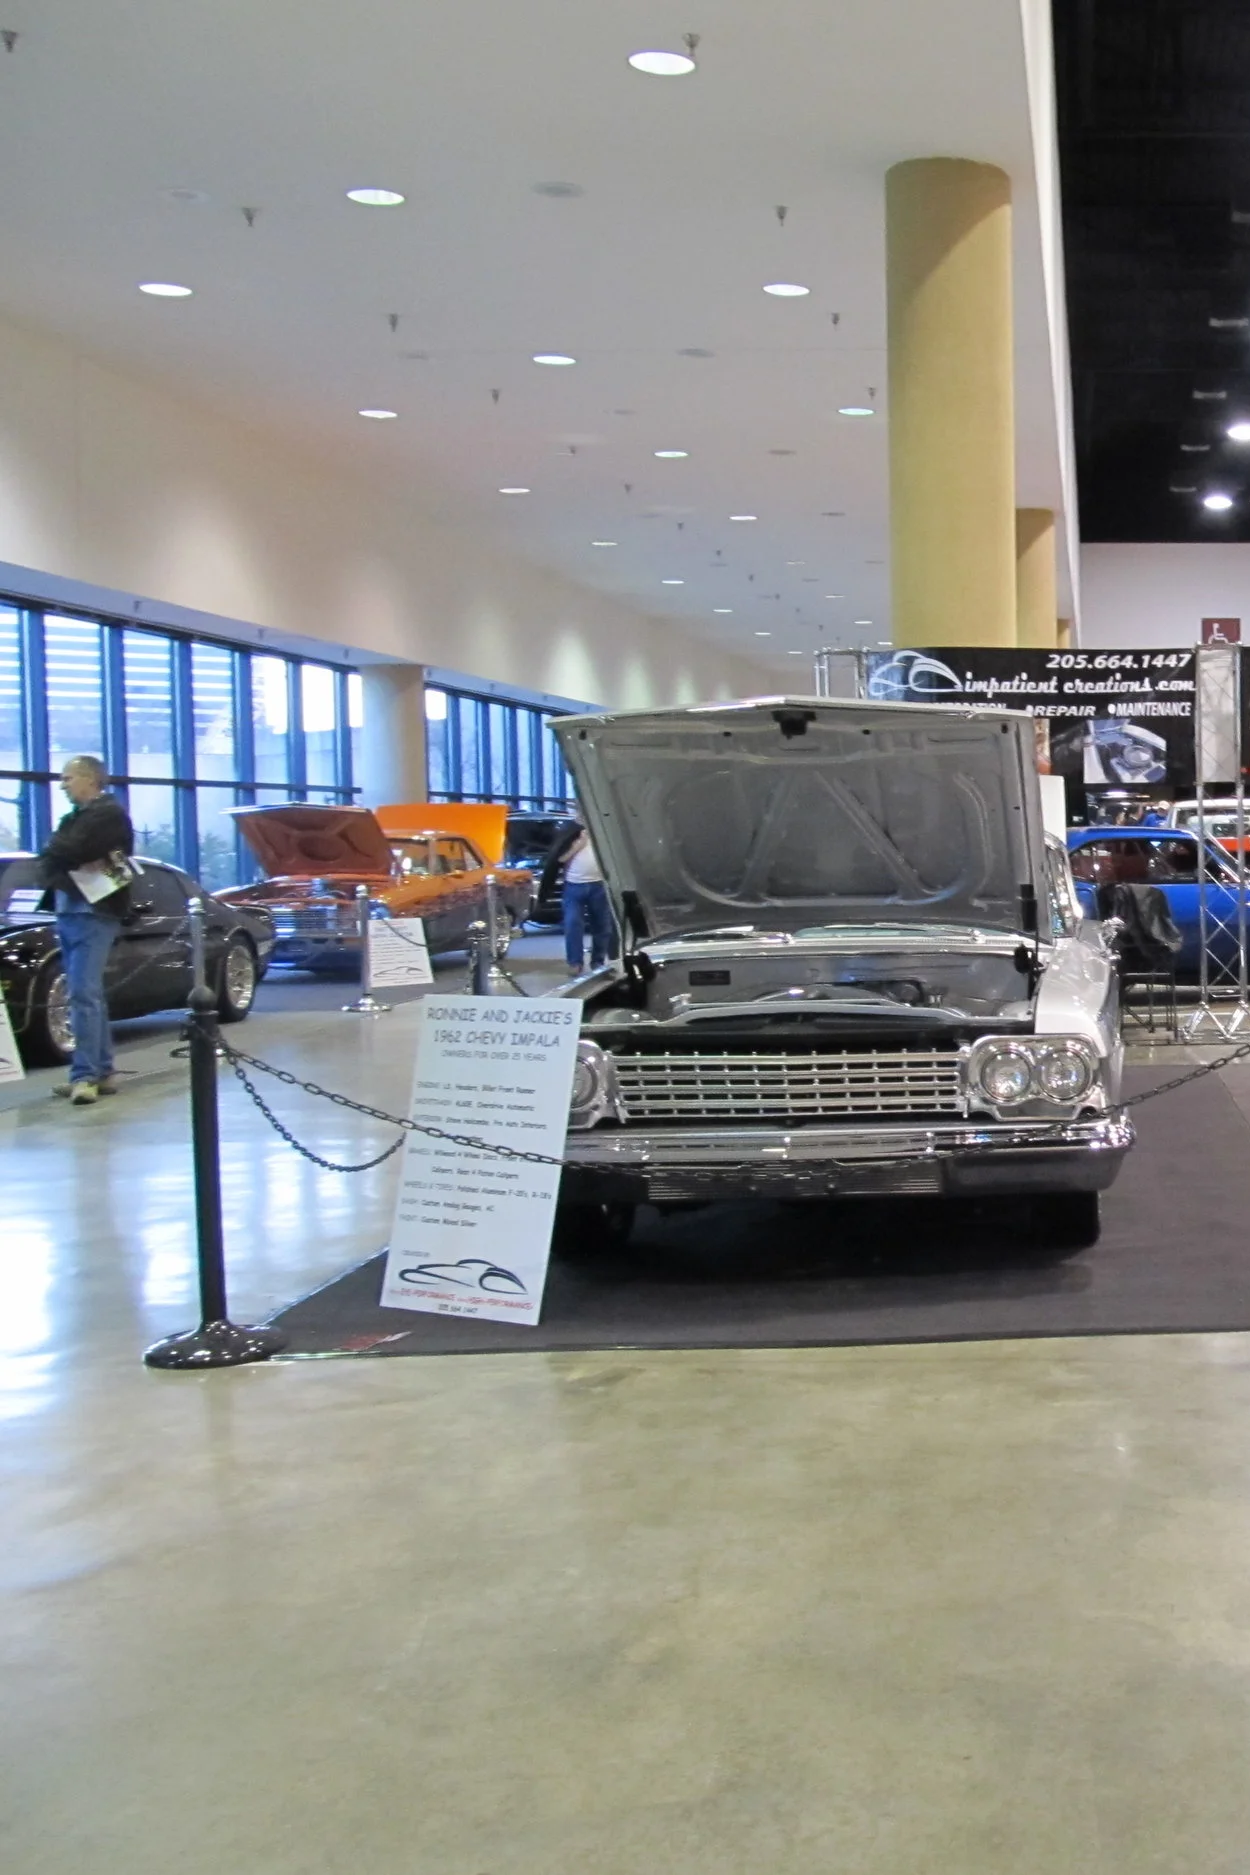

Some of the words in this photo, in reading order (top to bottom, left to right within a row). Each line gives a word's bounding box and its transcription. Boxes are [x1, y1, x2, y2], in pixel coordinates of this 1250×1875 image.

[1046, 653, 1192, 670] 205.664.1447
[964, 671, 1059, 699] impatient
[1035, 705, 1097, 717] REPAIR
[1116, 702, 1192, 717] MAINTENANCE
[426, 1007, 477, 1023] RONNIE
[480, 1009, 508, 1024] AND
[434, 1029, 461, 1043] 1962
[466, 1031, 507, 1045] CHEVY
[510, 1032, 560, 1047] IMPALA
